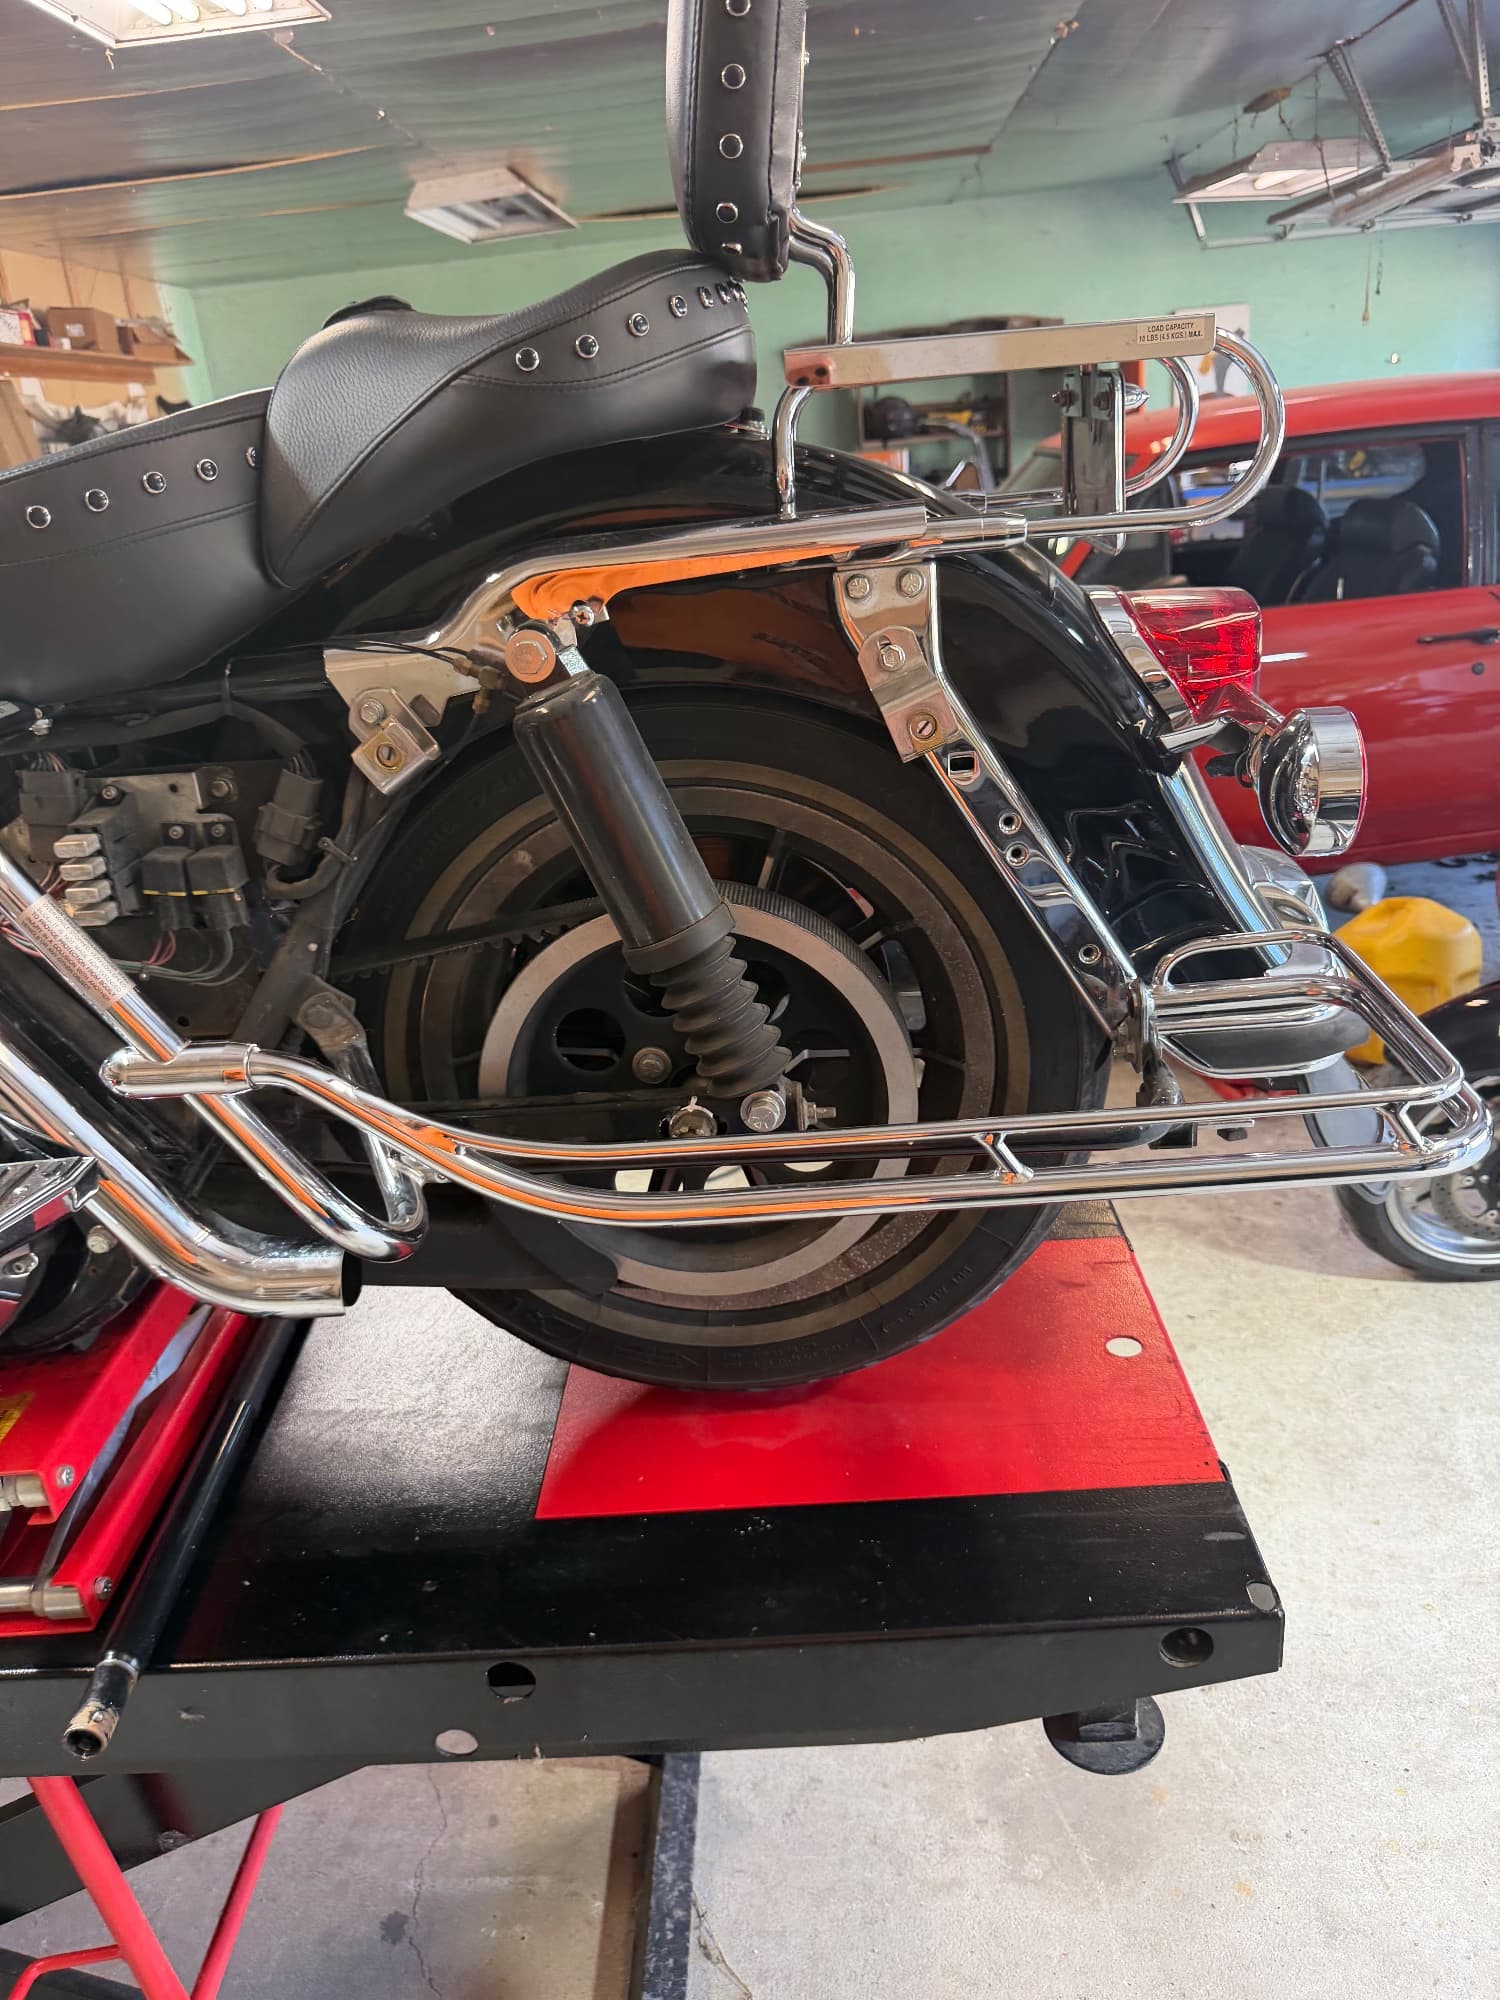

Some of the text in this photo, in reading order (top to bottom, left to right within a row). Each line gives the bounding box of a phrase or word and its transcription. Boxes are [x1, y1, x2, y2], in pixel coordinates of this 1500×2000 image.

[1148, 322, 1194, 332] LOAD CAPACITY
[1146, 334, 1158, 342] LBS
